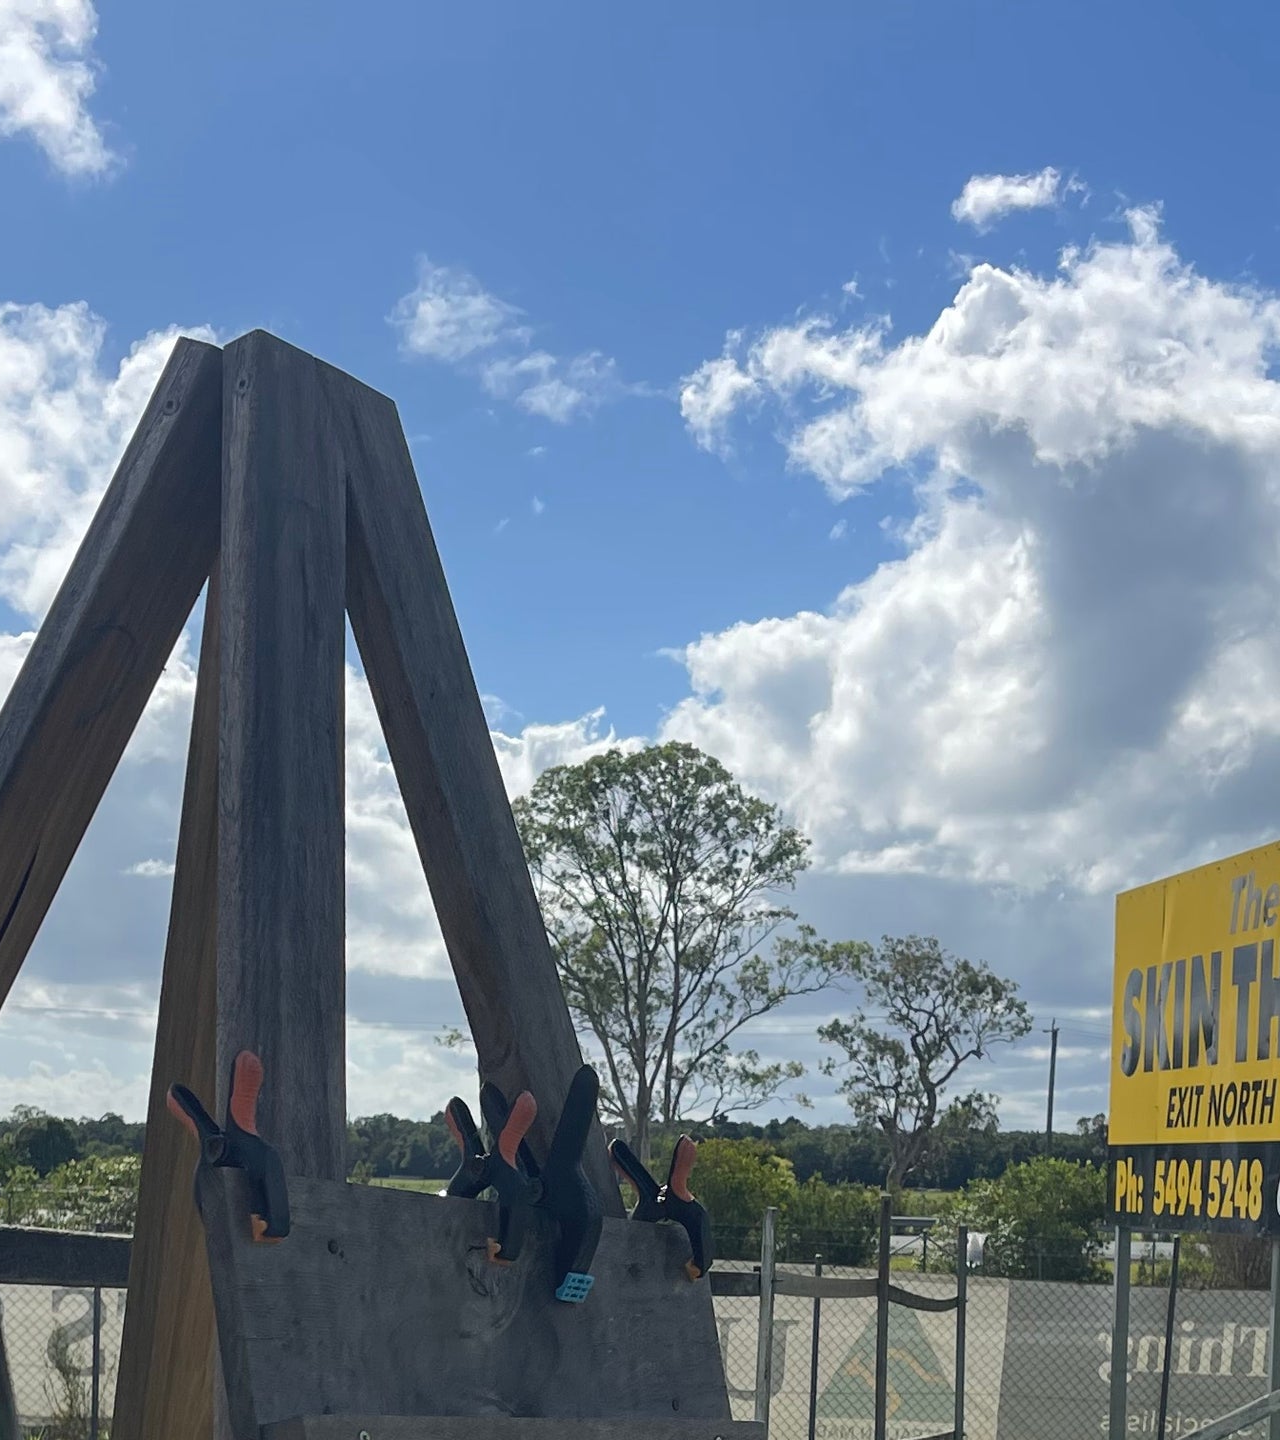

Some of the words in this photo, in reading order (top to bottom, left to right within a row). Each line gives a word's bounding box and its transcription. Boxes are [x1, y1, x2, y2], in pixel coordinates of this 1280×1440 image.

[1229, 869, 1280, 935] The
[1121, 950, 1222, 1077] SKIN
[1166, 1084, 1205, 1128] EXIT
[1207, 1078, 1277, 1128] NORTH
[1115, 1157, 1144, 1214] Ph:
[1152, 1158, 1203, 1217] 5494
[1207, 1158, 1264, 1221] 5248
